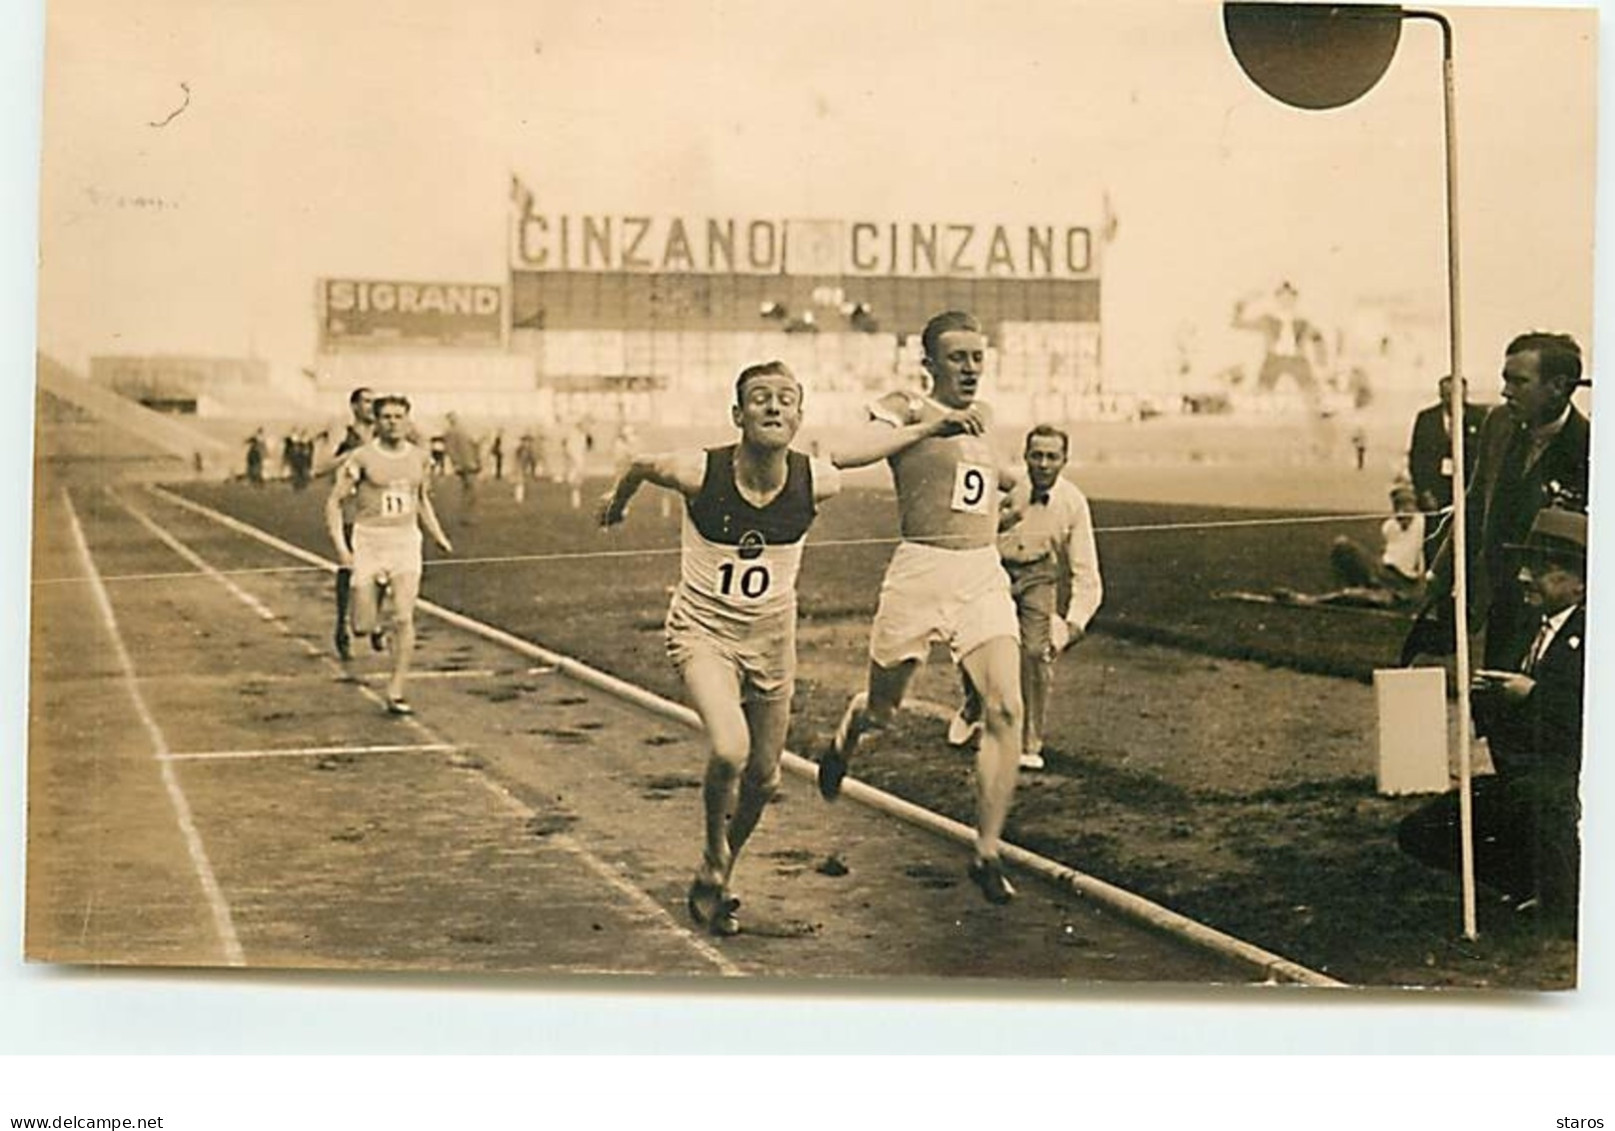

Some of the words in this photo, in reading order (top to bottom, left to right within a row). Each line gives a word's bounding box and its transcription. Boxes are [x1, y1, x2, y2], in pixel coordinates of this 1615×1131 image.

[518, 215, 776, 270] CINZANO
[851, 221, 1092, 274] CINZANO
[328, 281, 499, 316] SIGRAND
[386, 496, 403, 513] 11
[963, 469, 984, 506] 9
[718, 563, 770, 598] 10
